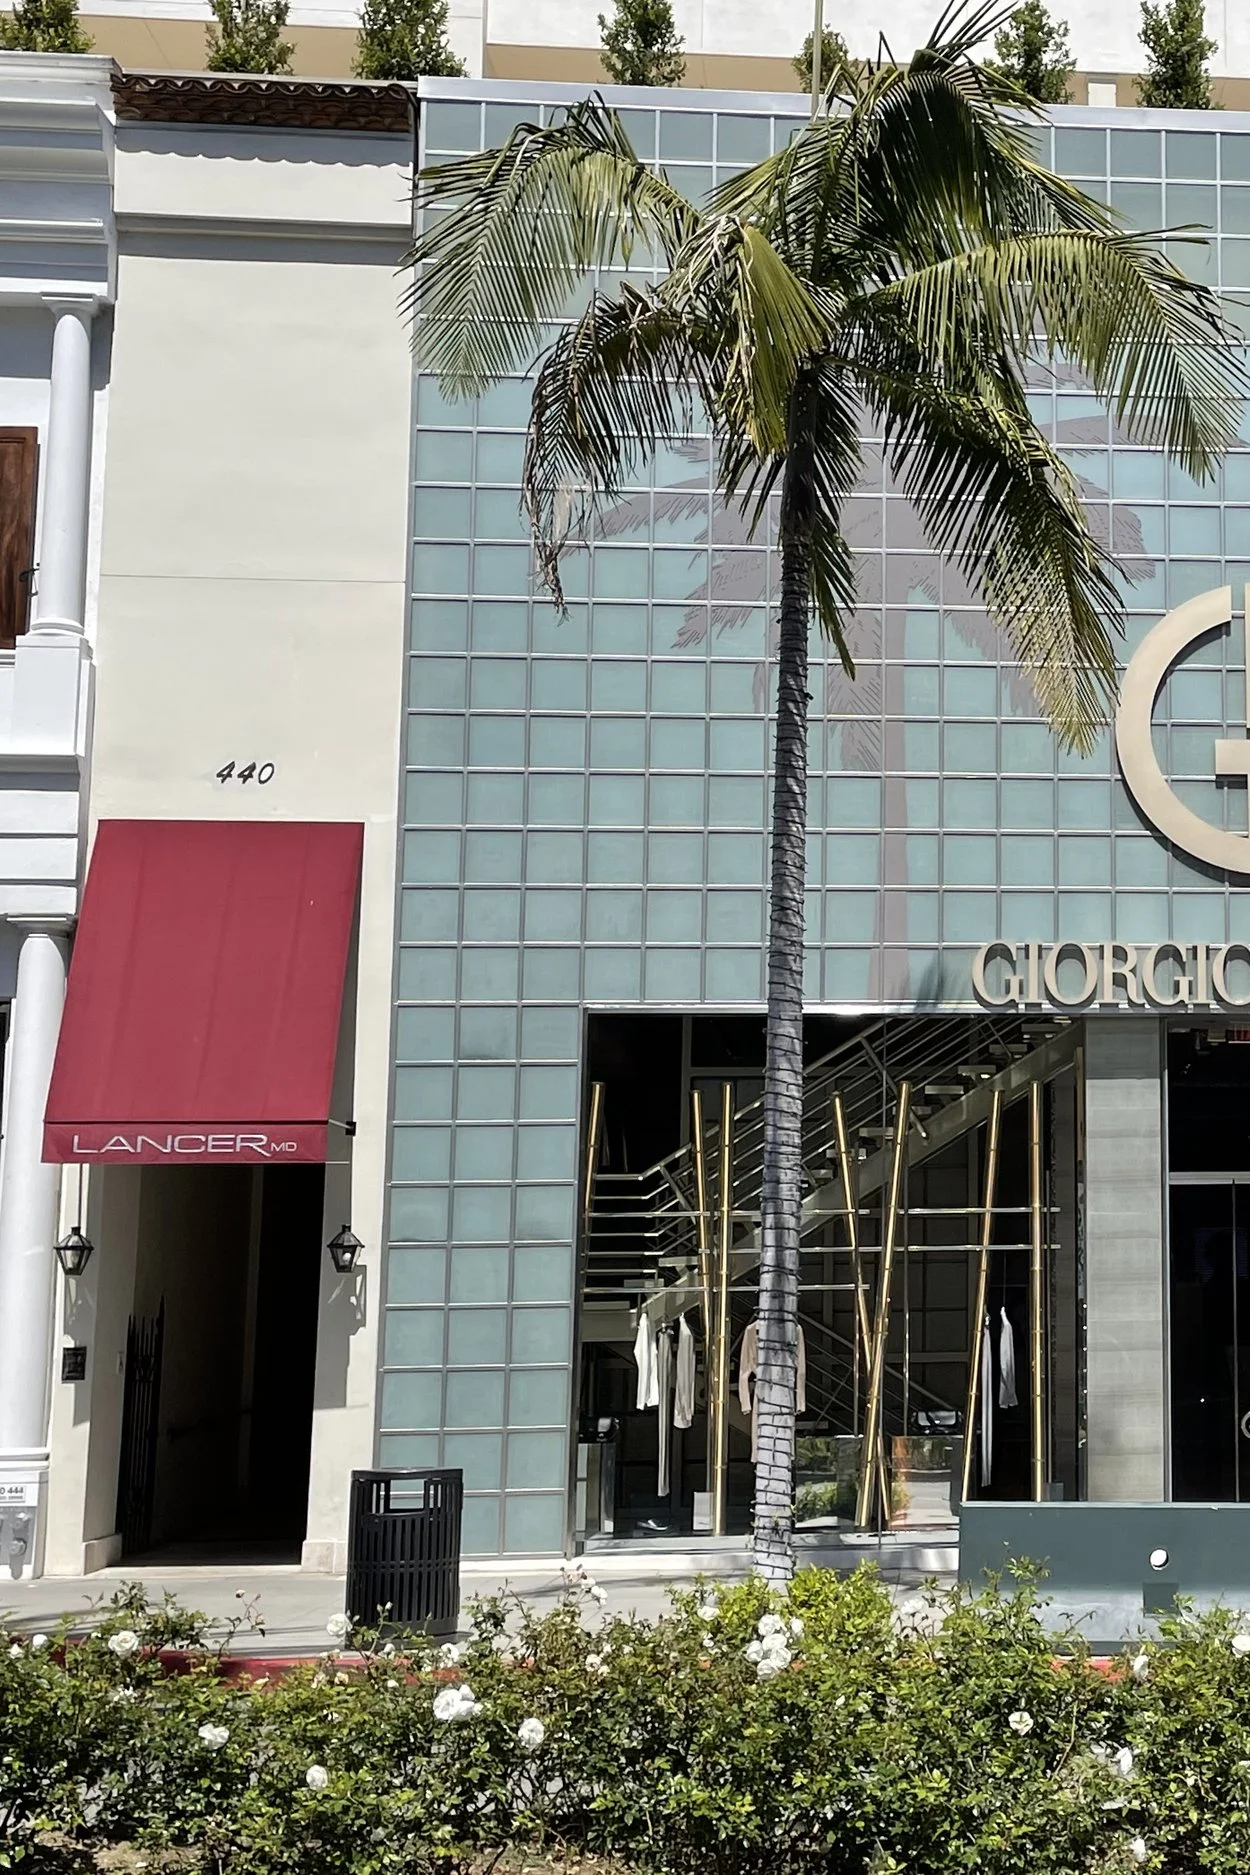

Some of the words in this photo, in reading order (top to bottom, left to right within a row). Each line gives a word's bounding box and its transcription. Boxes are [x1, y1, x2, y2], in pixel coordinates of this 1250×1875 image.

[216, 760, 275, 785] 440
[72, 1134, 272, 1157] LANCER
[270, 1141, 298, 1152] MD
